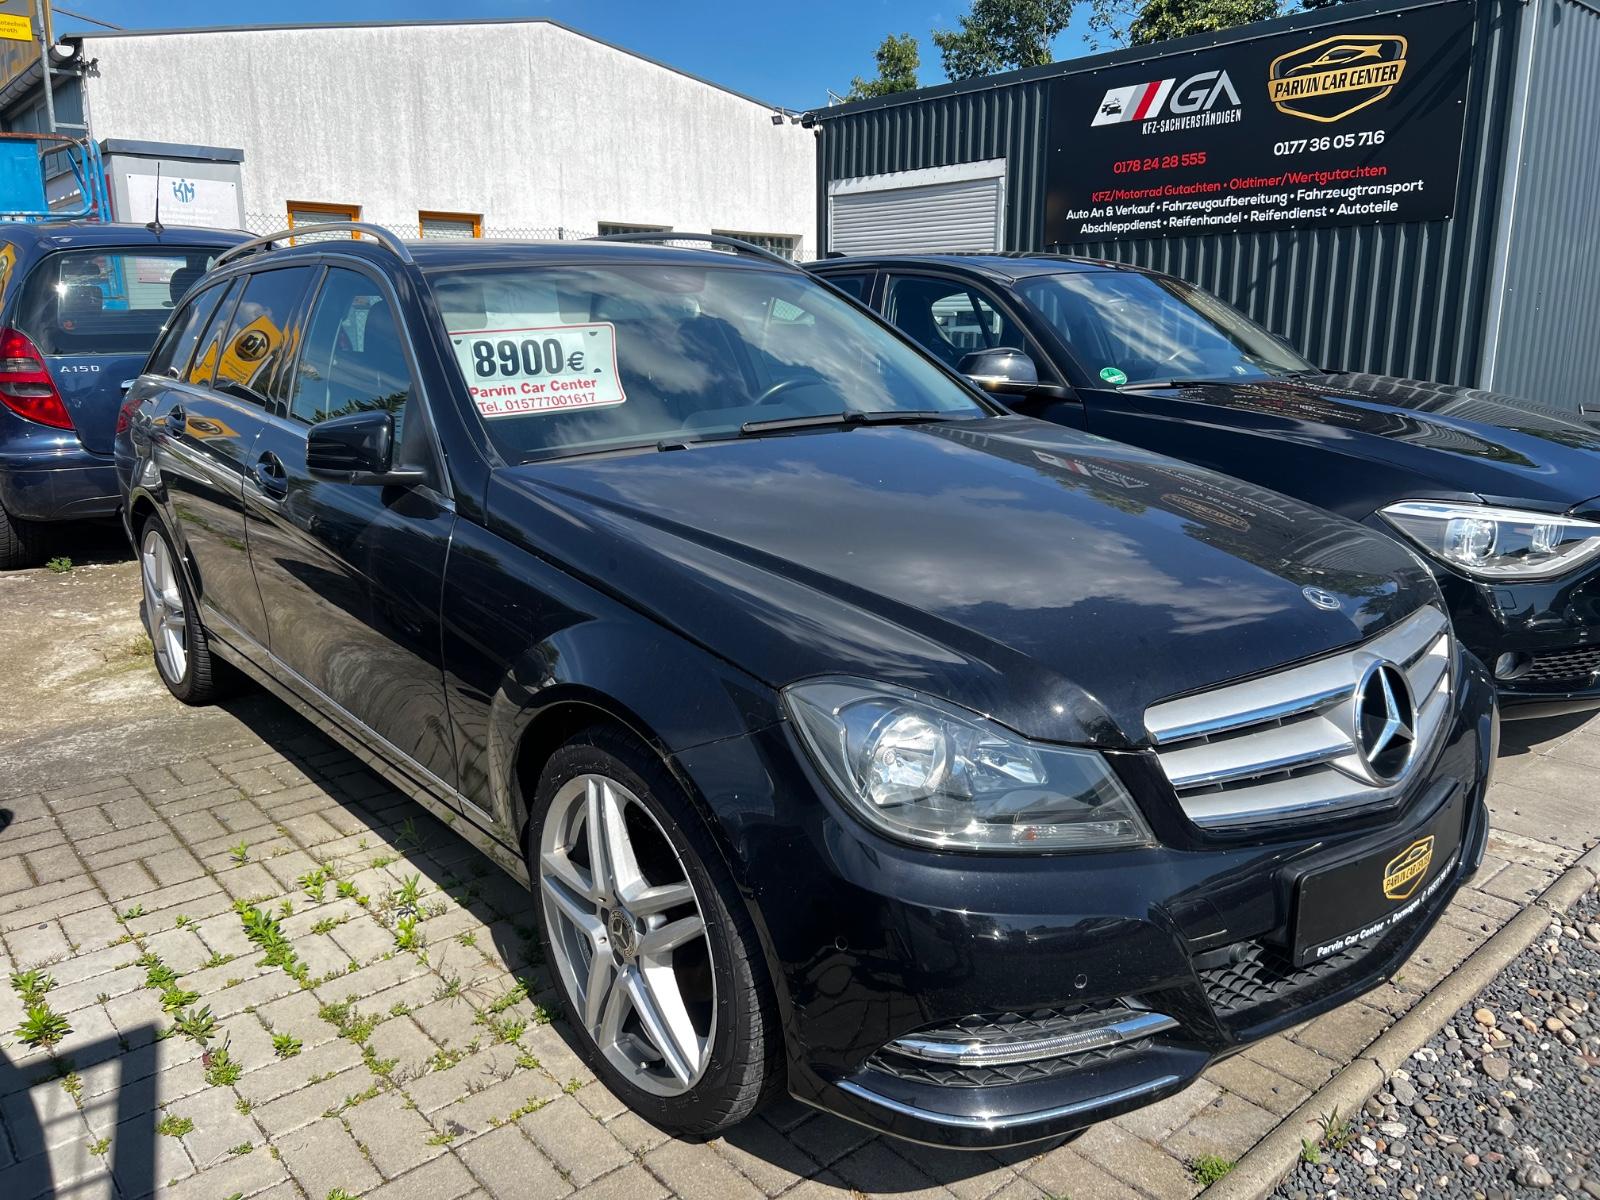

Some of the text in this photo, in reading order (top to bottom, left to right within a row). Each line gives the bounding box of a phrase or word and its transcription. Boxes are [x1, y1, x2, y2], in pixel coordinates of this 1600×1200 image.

[1169, 69, 1242, 114] GA
[1274, 64, 1398, 98] PARVIN CAR CENTER
[1142, 108, 1242, 135] KFZ-SACHVERSTÄNDIGEN
[1273, 130, 1385, 156] 0177 36 05 716
[1113, 152, 1206, 174] 0178 24 28 555
[1066, 179, 1424, 220] Auto An & Verkauf Fahrzeugaufbereitung Fahrzeugtransport
[1092, 165, 1387, 202] KFZ/Motorrad Gutachten Oldtimer/Wertgutachten
[1080, 200, 1398, 234] Abschleppdienst Reifenhandel Reifendienst Autoteile
[469, 378, 597, 398] Parvin Car Center
[478, 392, 596, 413] Tel. 015777001617
[1317, 940, 1343, 957] Parvin
[1344, 933, 1358, 945] Car
[1359, 922, 1384, 939] Center
